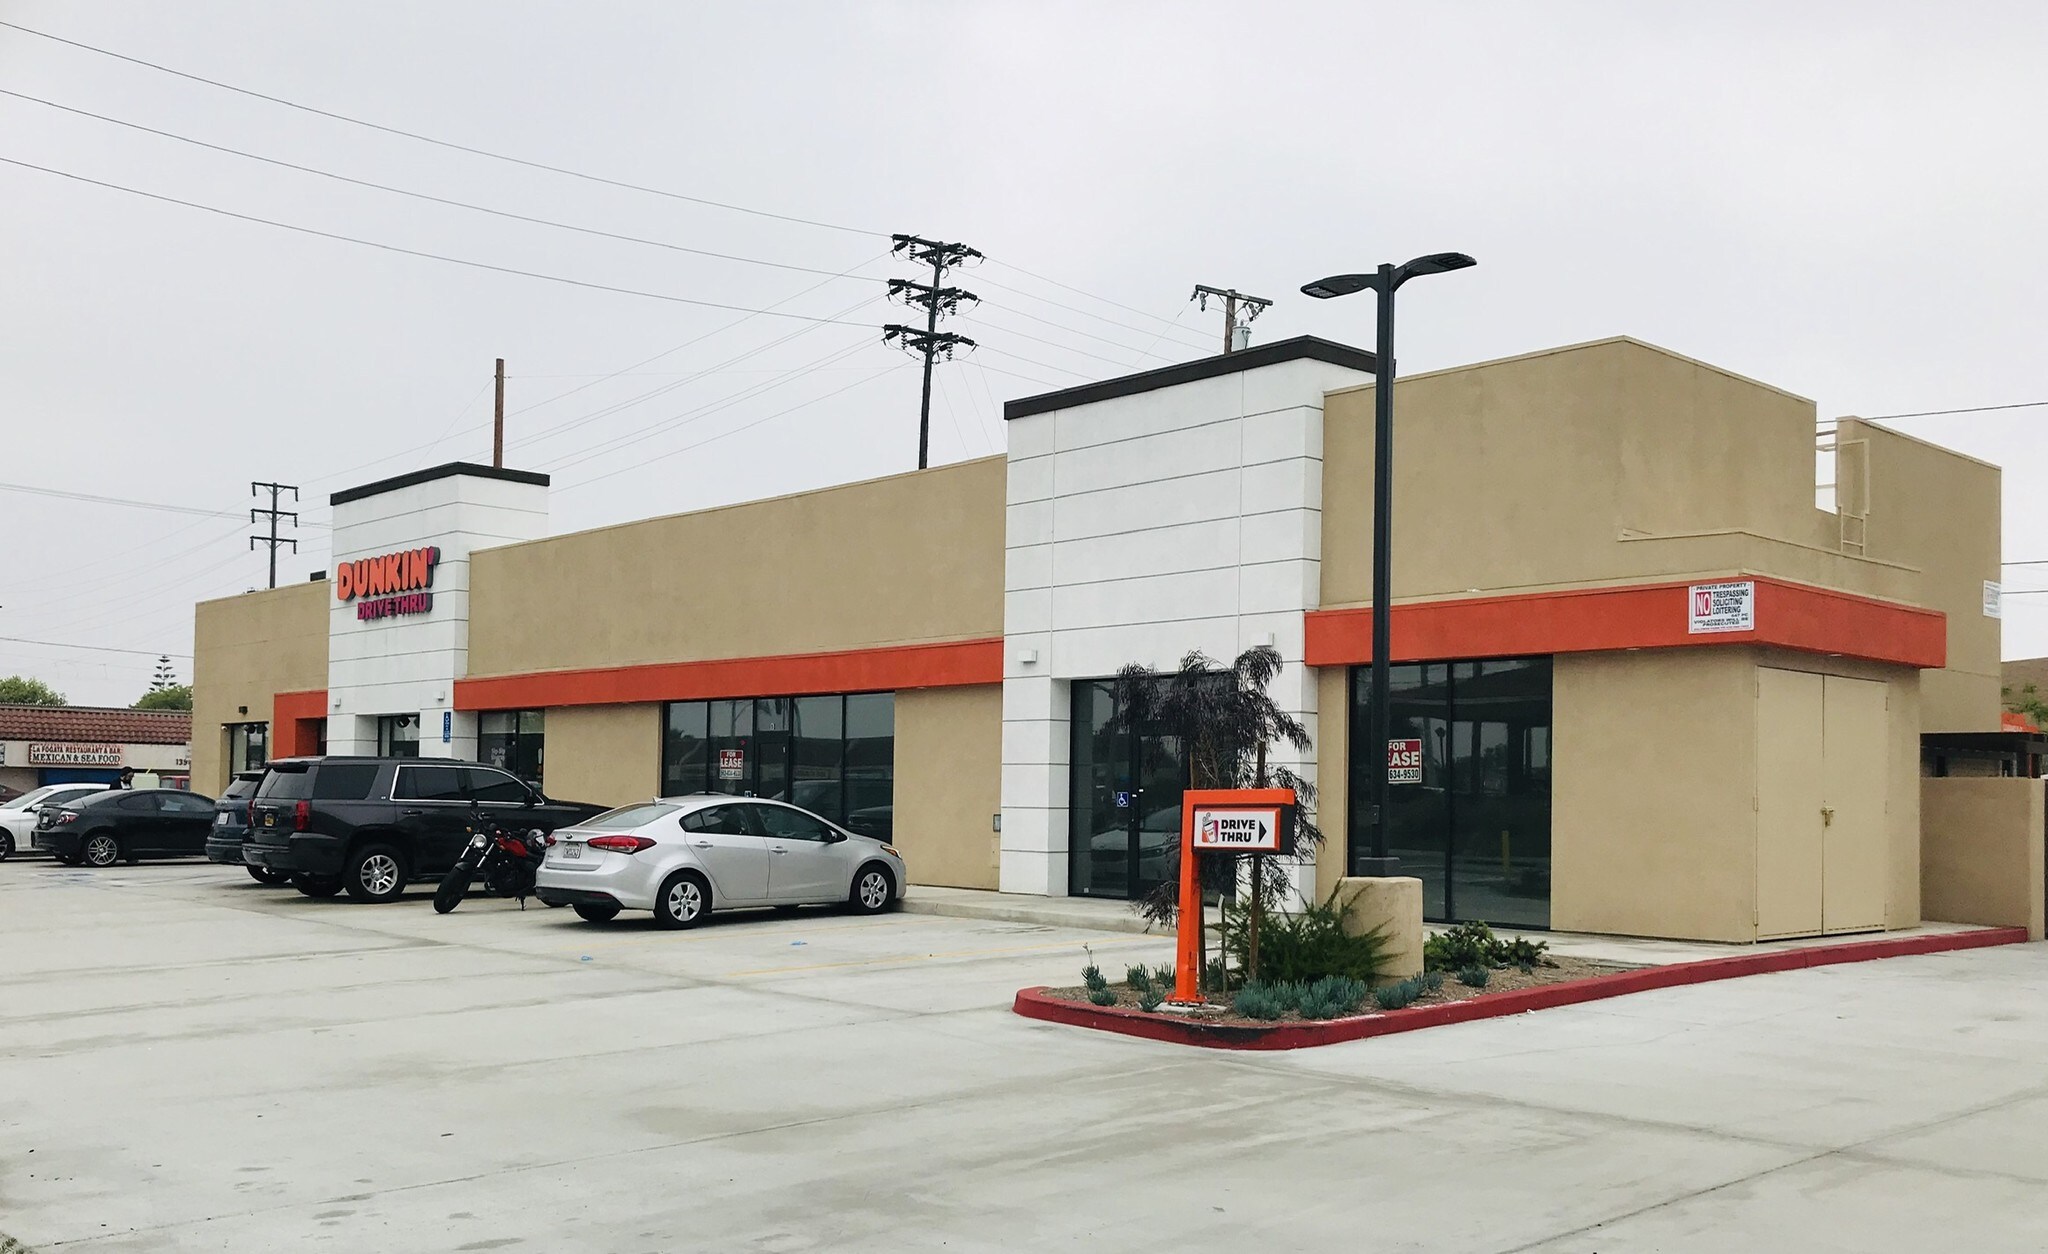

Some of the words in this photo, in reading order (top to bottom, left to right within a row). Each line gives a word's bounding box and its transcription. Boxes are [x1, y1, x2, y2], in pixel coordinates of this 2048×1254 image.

[338, 546, 440, 601] DUNKIN'
[1713, 589, 1748, 598] TRESPASSING
[358, 598, 392, 620] DRIVE
[394, 592, 433, 615] THRU
[1696, 593, 1711, 616] NO
[1713, 597, 1742, 606] SOLICITING
[1713, 605, 1741, 615] LOITERING
[1389, 742, 1406, 750] FOR
[32, 753, 71, 762] MEXICAN
[81, 754, 97, 762] SEA
[98, 755, 120, 763] FOOD
[721, 758, 742, 768] LEASE
[1221, 819, 1256, 830] DRIVE
[1220, 832, 1252, 843] THRU
